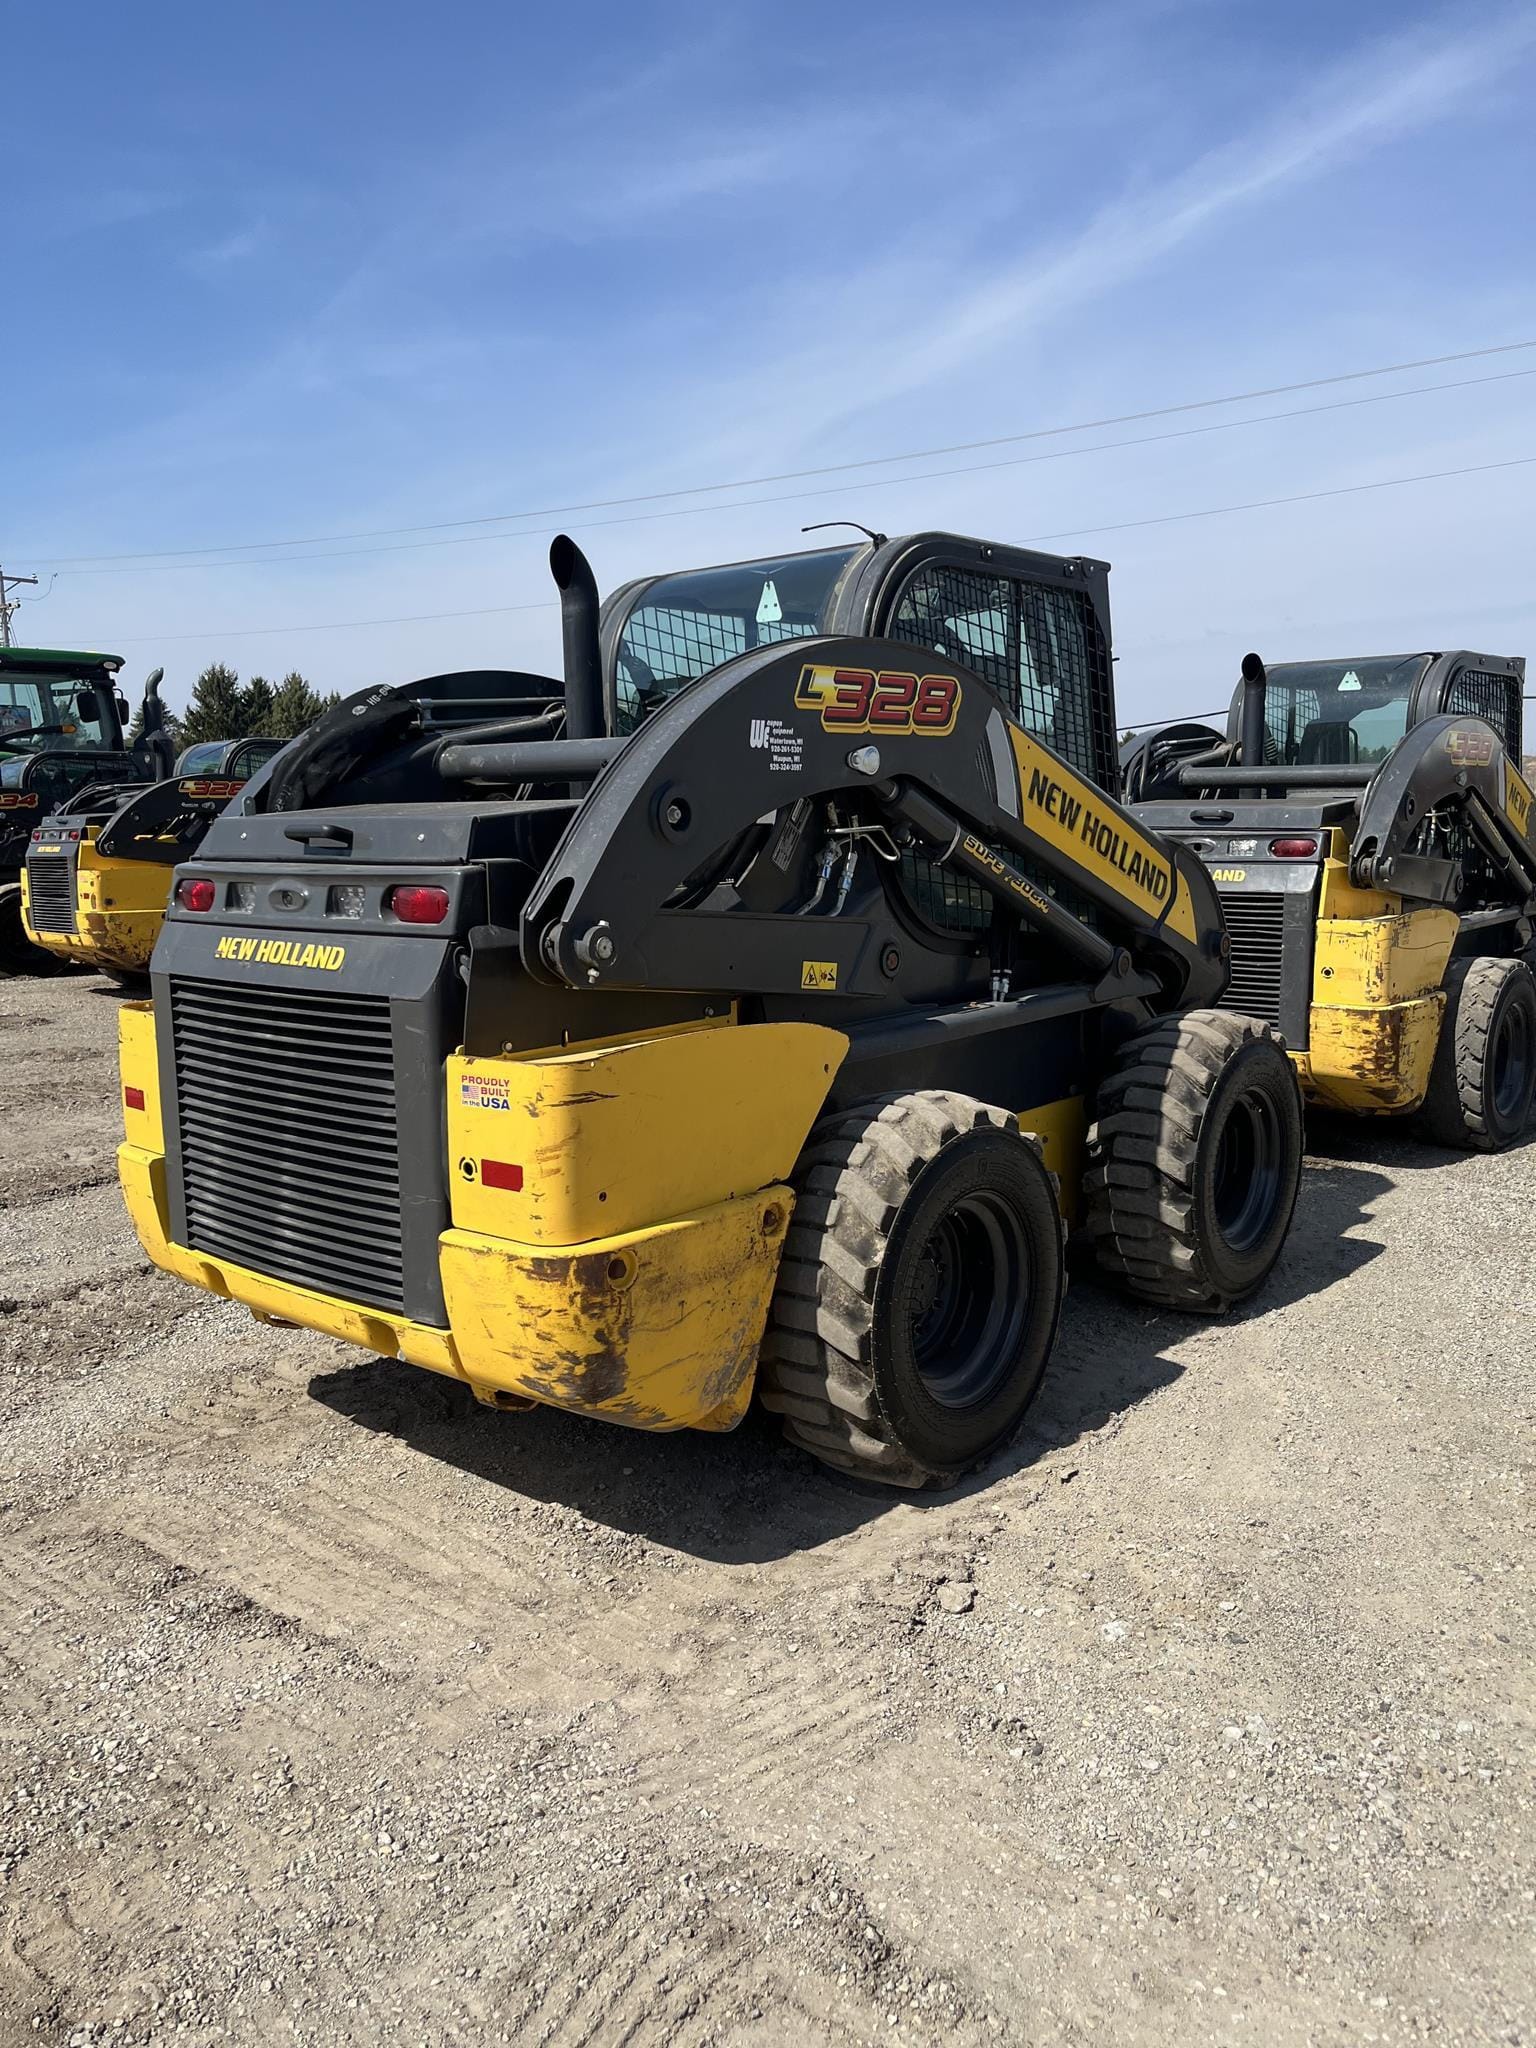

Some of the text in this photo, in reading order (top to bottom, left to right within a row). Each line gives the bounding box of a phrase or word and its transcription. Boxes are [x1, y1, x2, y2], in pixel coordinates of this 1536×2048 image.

[795, 664, 962, 736] L328
[1508, 783, 1527, 819] NEW
[1028, 768, 1168, 901] NEW HOLLAND
[1208, 868, 1246, 882] AND
[214, 937, 345, 971] NEW HOLLAND
[461, 1075, 510, 1087] PROUDLY
[480, 1086, 511, 1097] BUILT
[480, 1097, 511, 1110] USA
